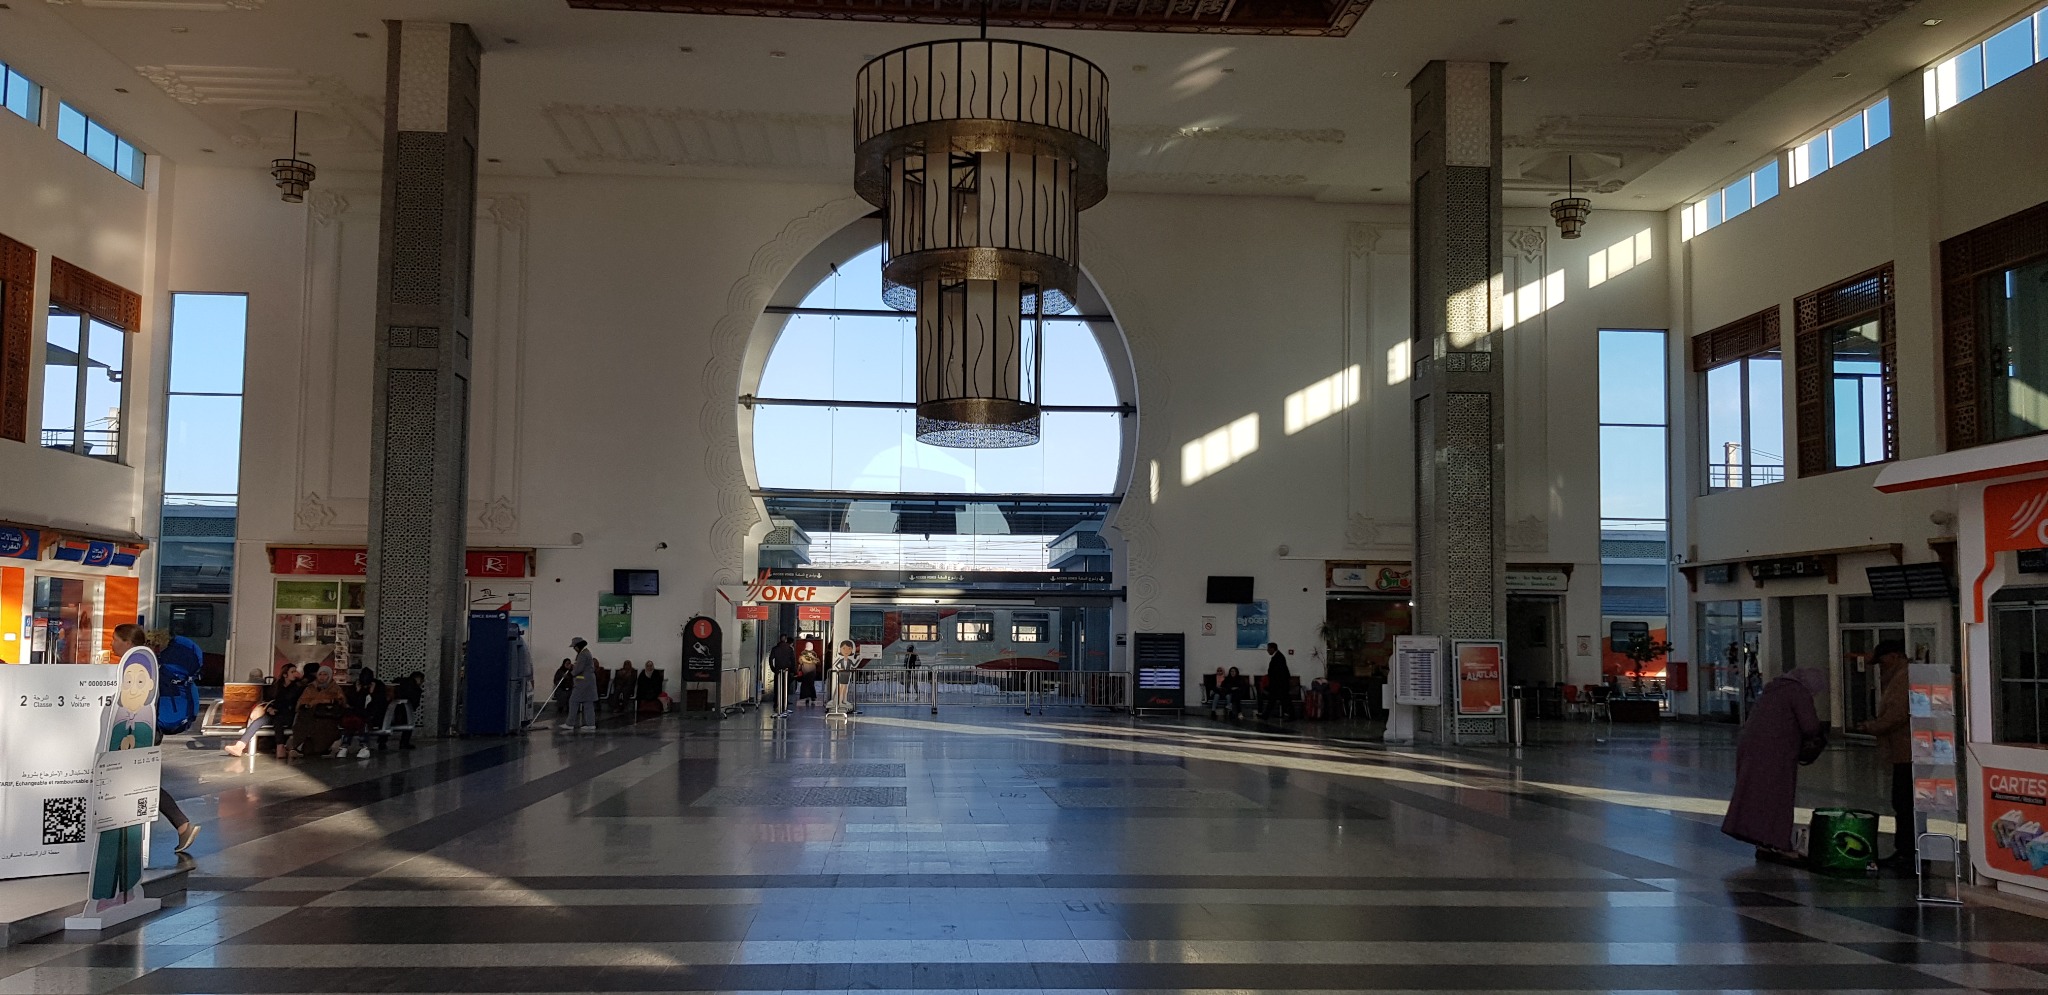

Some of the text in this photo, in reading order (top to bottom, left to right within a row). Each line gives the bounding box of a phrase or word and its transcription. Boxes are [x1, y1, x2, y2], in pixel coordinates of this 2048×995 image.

[761, 586, 817, 601] ONCF
[20, 695, 28, 707] 2
[58, 695, 65, 707] 3
[1989, 774, 2048, 797] CARTES
